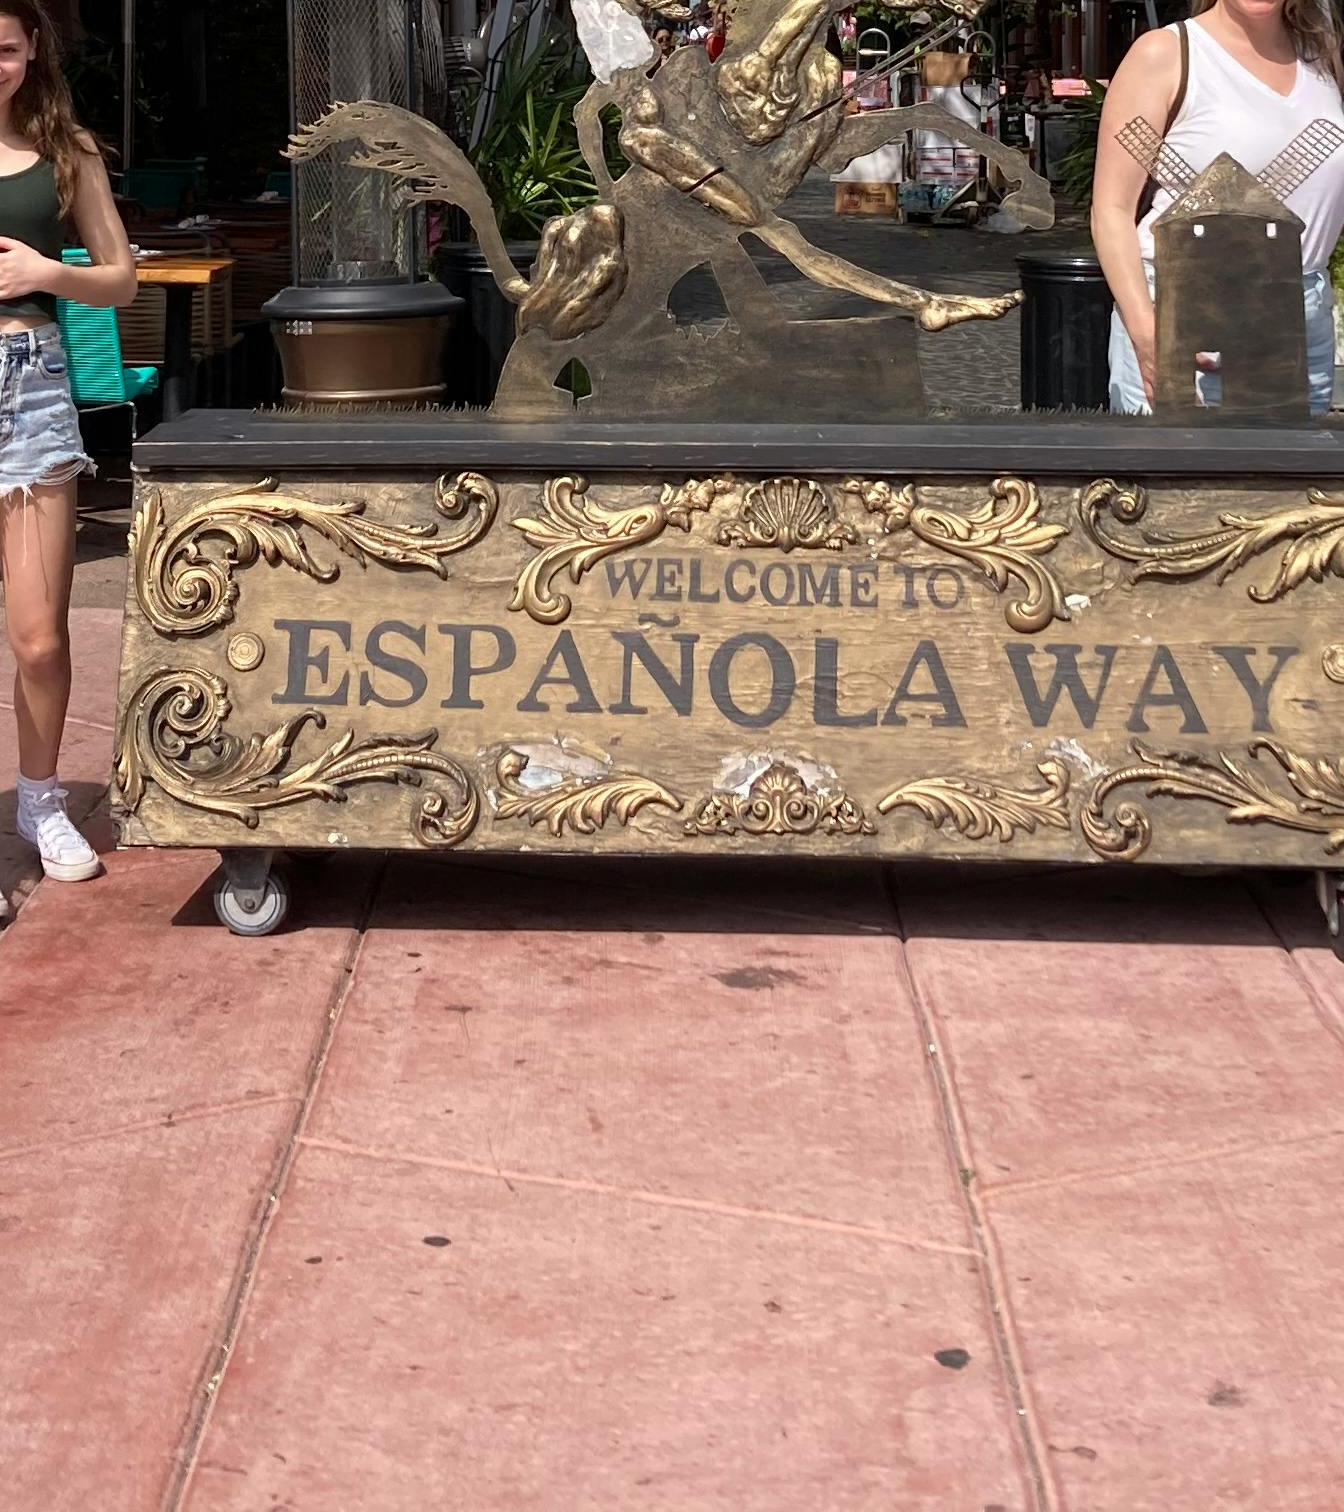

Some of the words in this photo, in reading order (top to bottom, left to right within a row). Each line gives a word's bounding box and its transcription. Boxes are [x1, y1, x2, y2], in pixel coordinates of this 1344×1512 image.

[604, 558, 879, 609] WELCOME
[899, 564, 964, 611] TO
[271, 614, 968, 730] ESPAÑOLA
[1004, 642, 1300, 735] WAY
